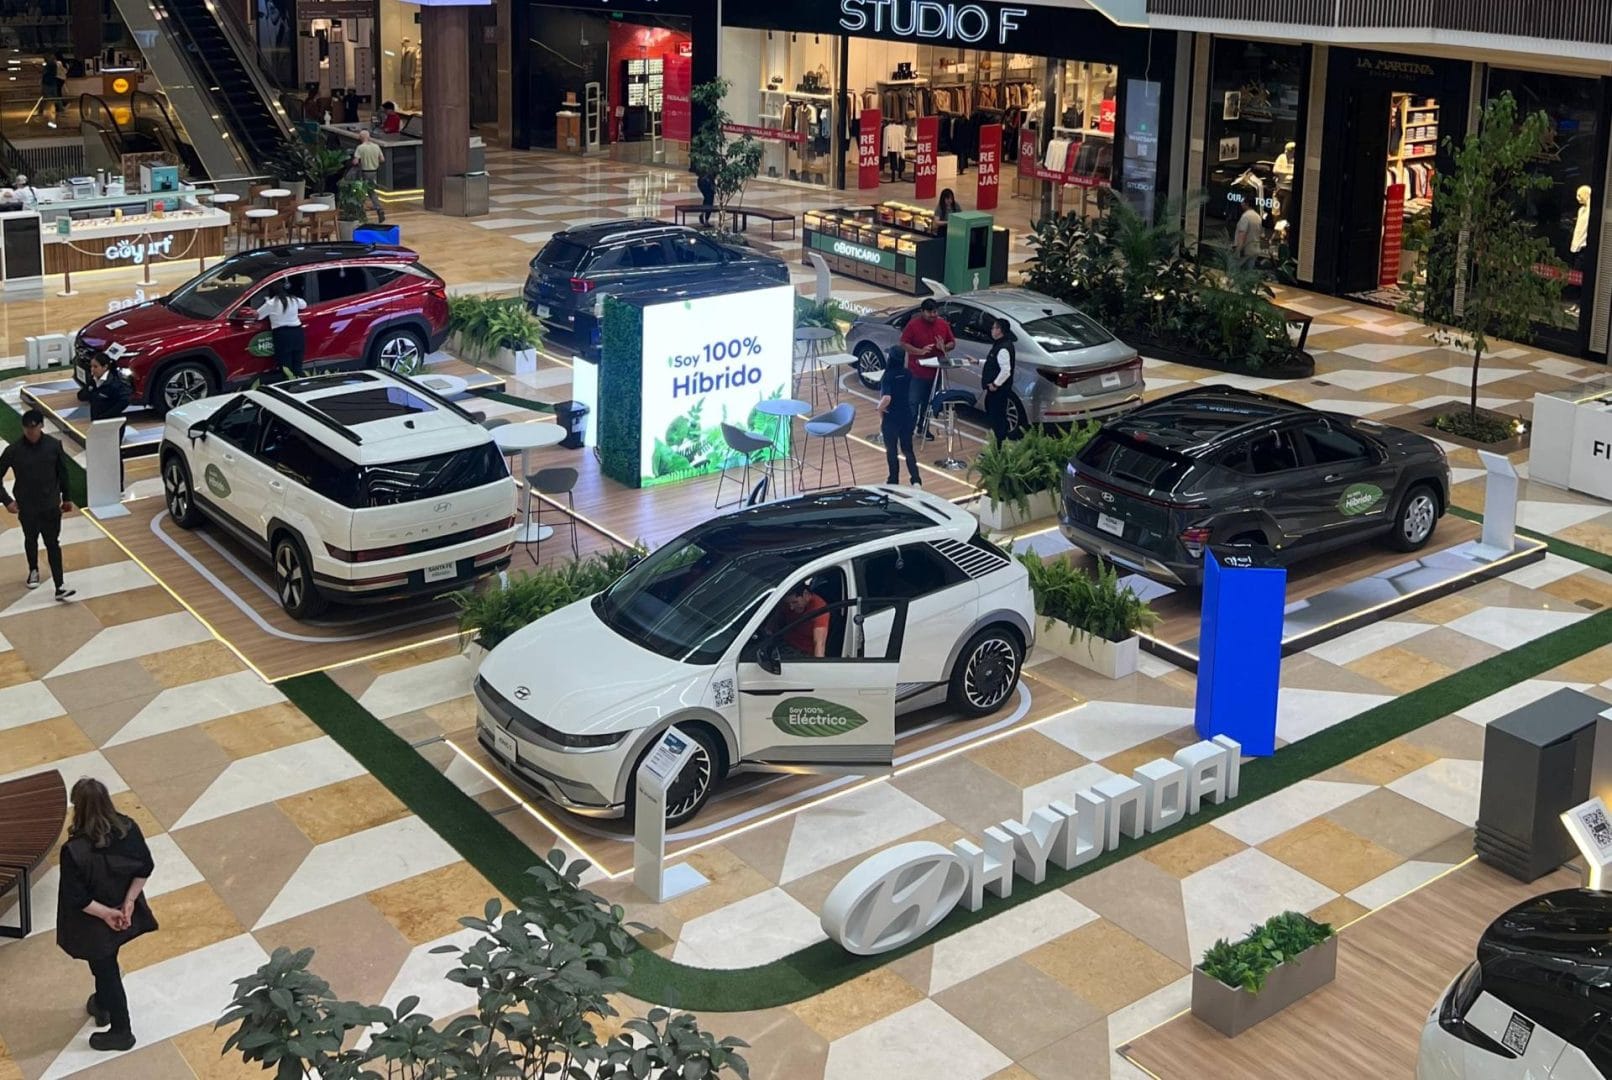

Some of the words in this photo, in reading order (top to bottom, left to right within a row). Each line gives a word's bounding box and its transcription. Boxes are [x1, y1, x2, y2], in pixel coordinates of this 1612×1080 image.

[839, 0, 988, 42] STUDIO
[999, 8, 1027, 44] F
[861, 134, 874, 144] RE
[860, 145, 875, 156] BA
[917, 142, 931, 153] RE
[1022, 144, 1033, 156] 50
[860, 156, 880, 167] JAS
[917, 154, 932, 165] BA
[980, 152, 995, 162] RE
[917, 165, 937, 176] JAS
[980, 164, 994, 174] BA
[979, 175, 998, 186] JAS
[674, 355, 700, 368] Soy
[703, 336, 762, 363] 100%
[673, 364, 762, 398] Híbrido
[789, 714, 847, 725] Eléctrico
[953, 734, 1241, 913] HYUNDAI
